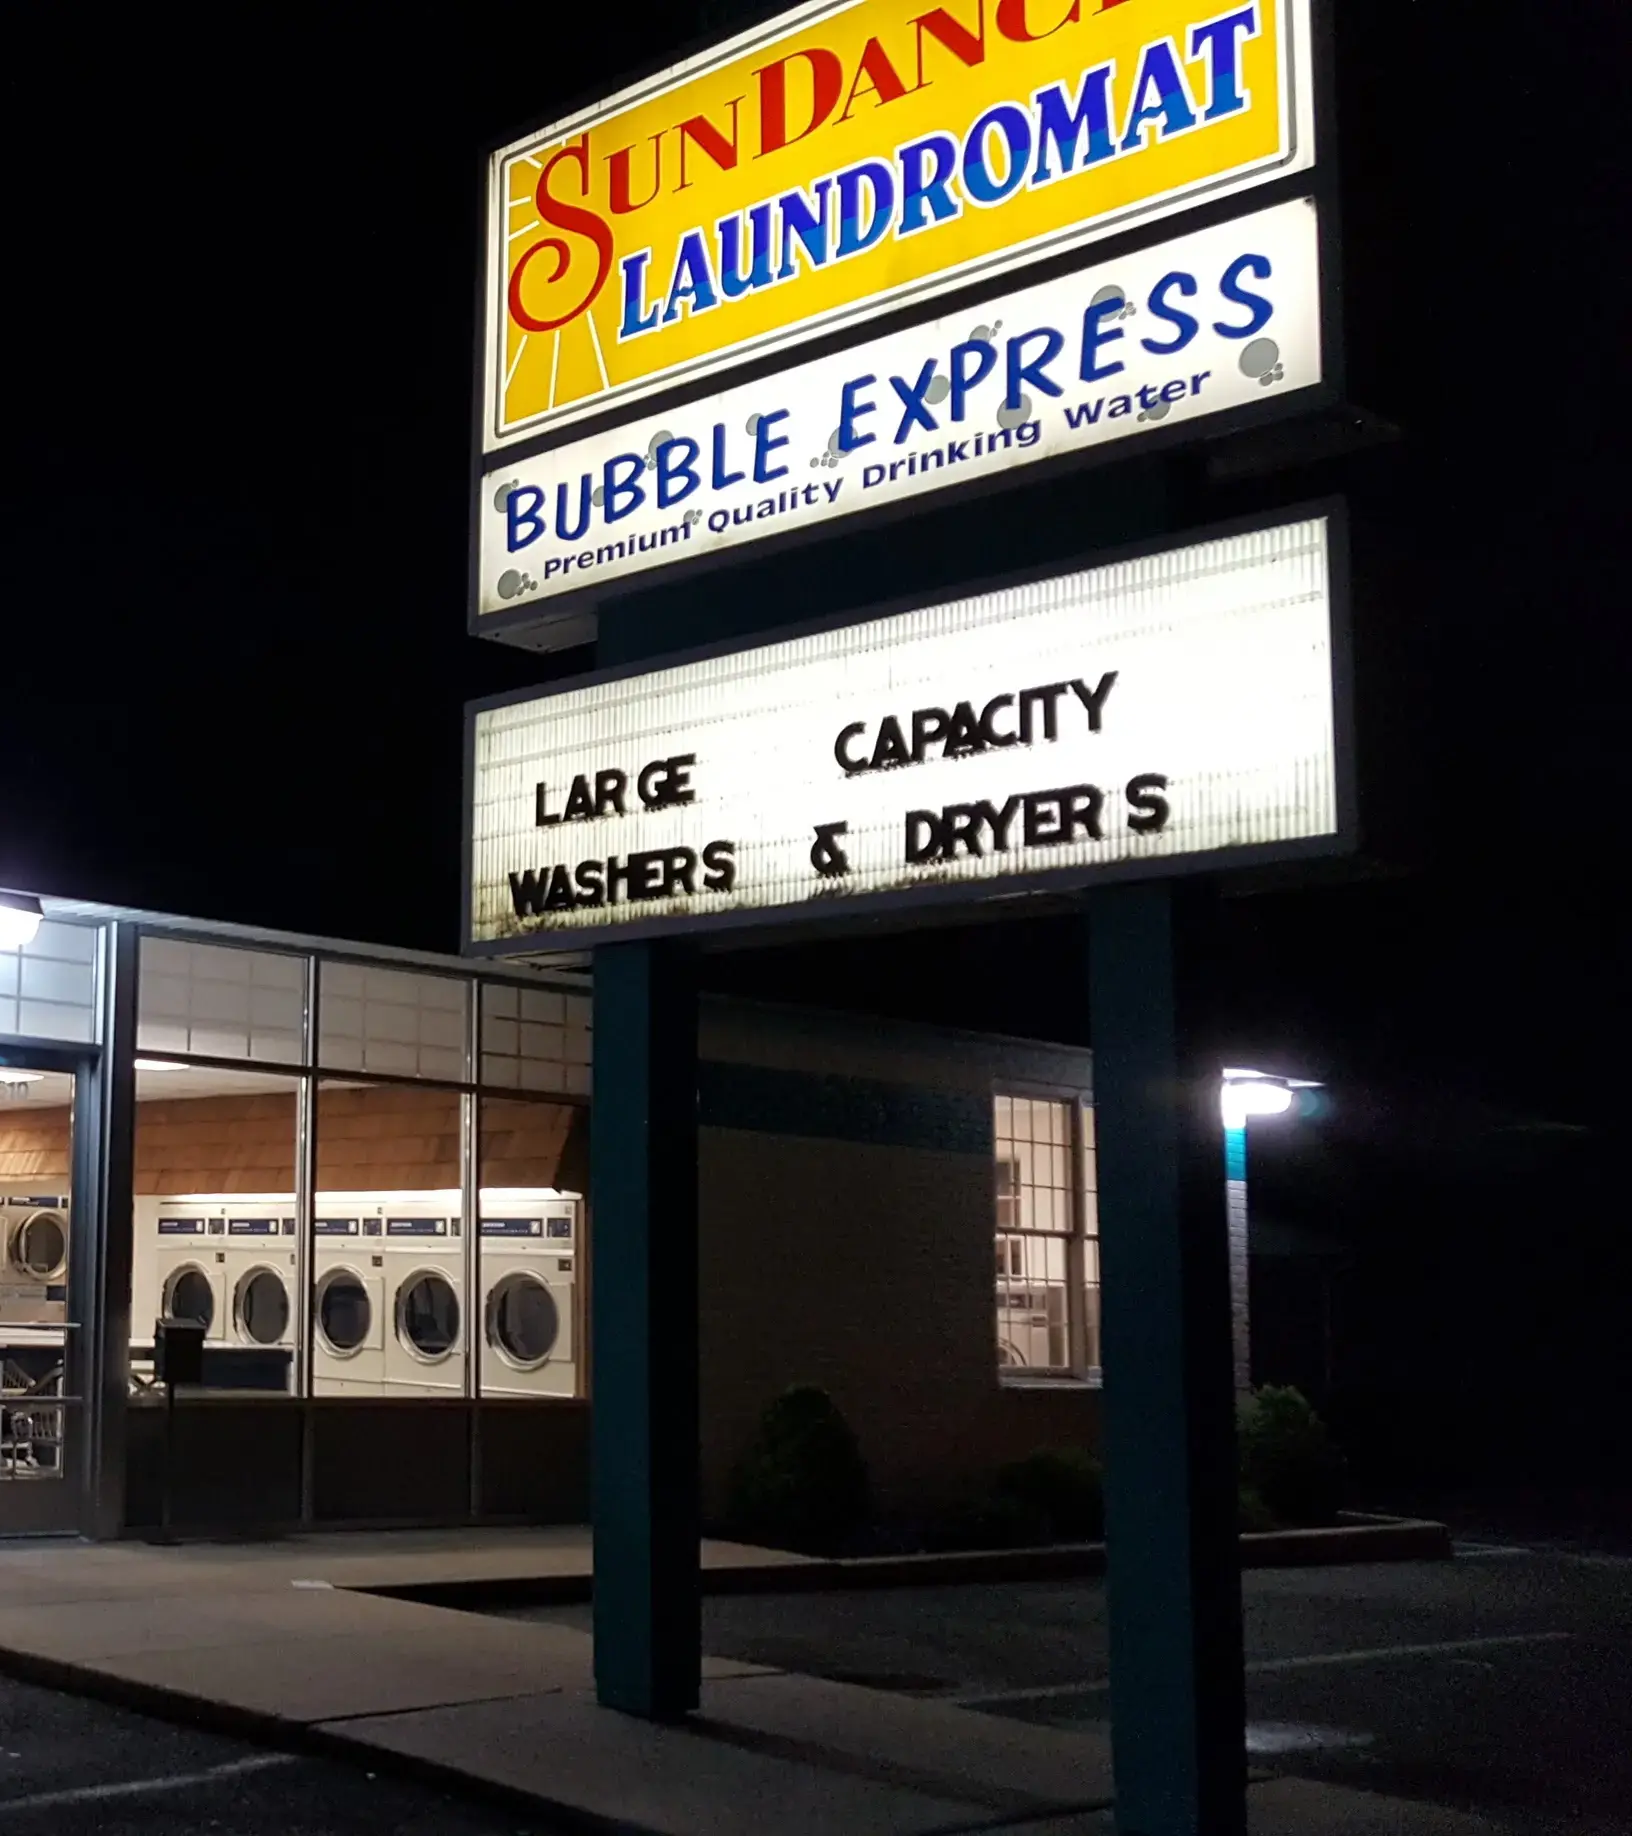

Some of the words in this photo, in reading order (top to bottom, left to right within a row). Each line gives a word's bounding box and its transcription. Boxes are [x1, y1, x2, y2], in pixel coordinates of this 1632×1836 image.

[618, 6, 1257, 339] LAUNDROMAT
[506, 409, 790, 553] BUBBLE
[838, 253, 1273, 446] EXPRESS
[543, 520, 693, 580] Premium
[707, 476, 844, 533] Quality
[862, 418, 1042, 490] Drinking
[1063, 369, 1212, 430] Water
[833, 670, 1120, 779] CAPACITY
[507, 840, 739, 919] WASHERS
[809, 820, 851, 878] &
